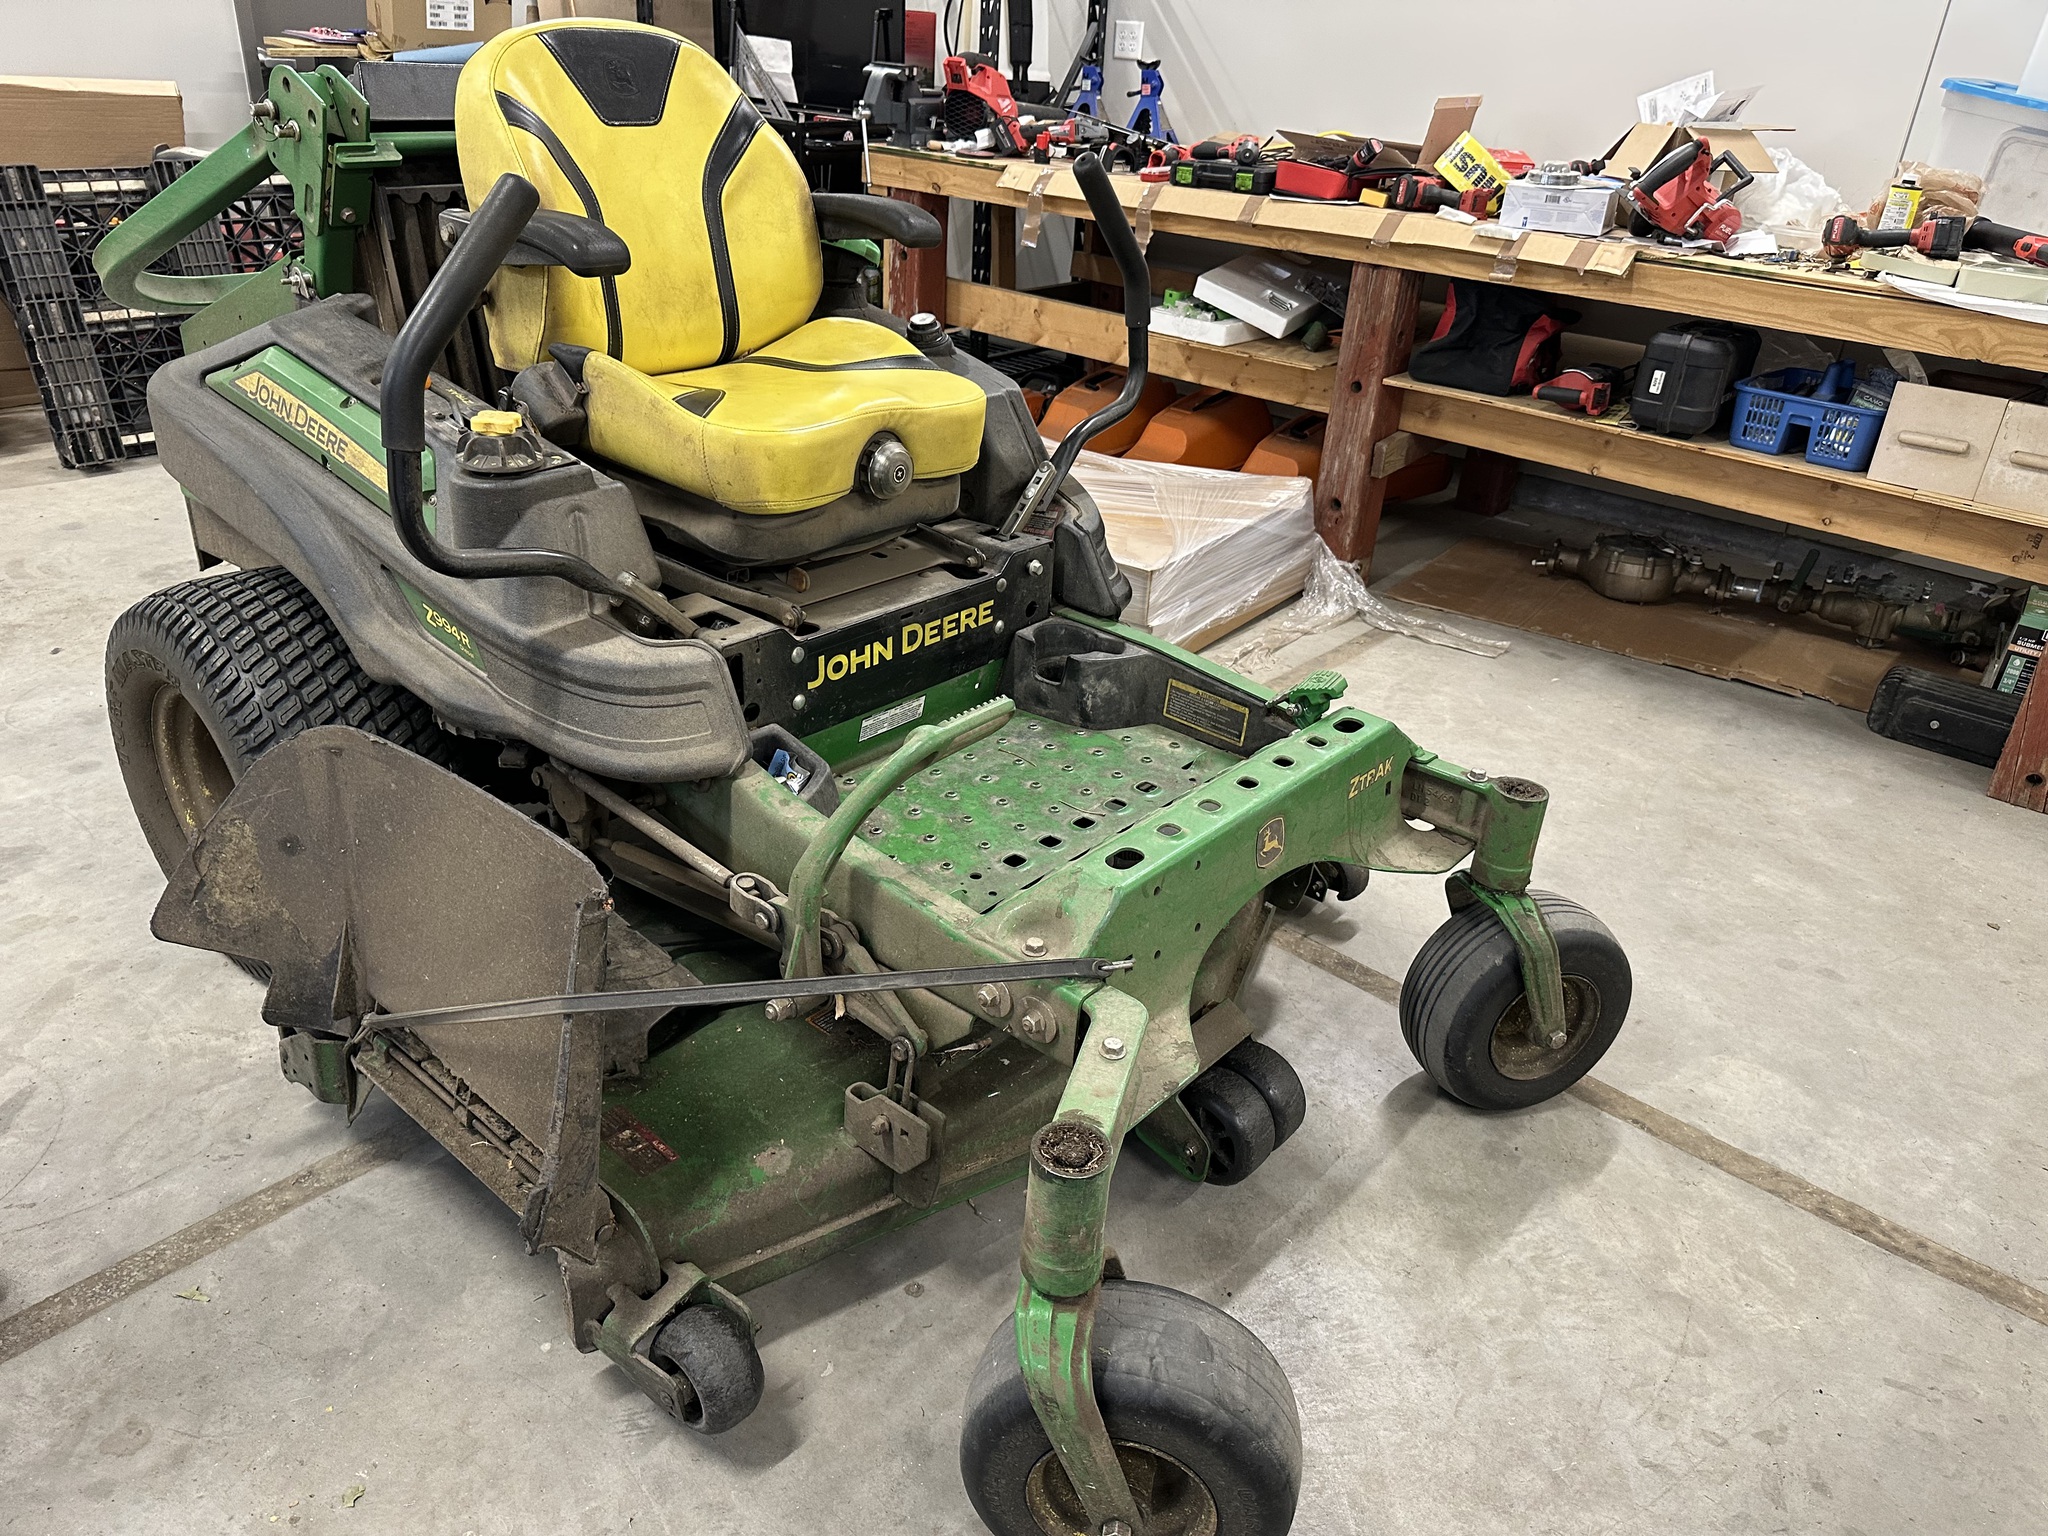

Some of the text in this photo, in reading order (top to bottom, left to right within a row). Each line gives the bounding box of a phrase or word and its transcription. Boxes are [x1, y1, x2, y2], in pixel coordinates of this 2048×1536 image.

[1719, 224, 1733, 235] FUEL
[1832, 220, 1840, 239] FUEL
[248, 376, 349, 461] JOHN DEERE
[422, 603, 472, 649] Z994R
[807, 599, 995, 690] JOHN DEERE
[112, 649, 181, 688] MASTER
[2014, 646, 2038, 656] UTILITY
[1348, 755, 1394, 800] ZTRAK
